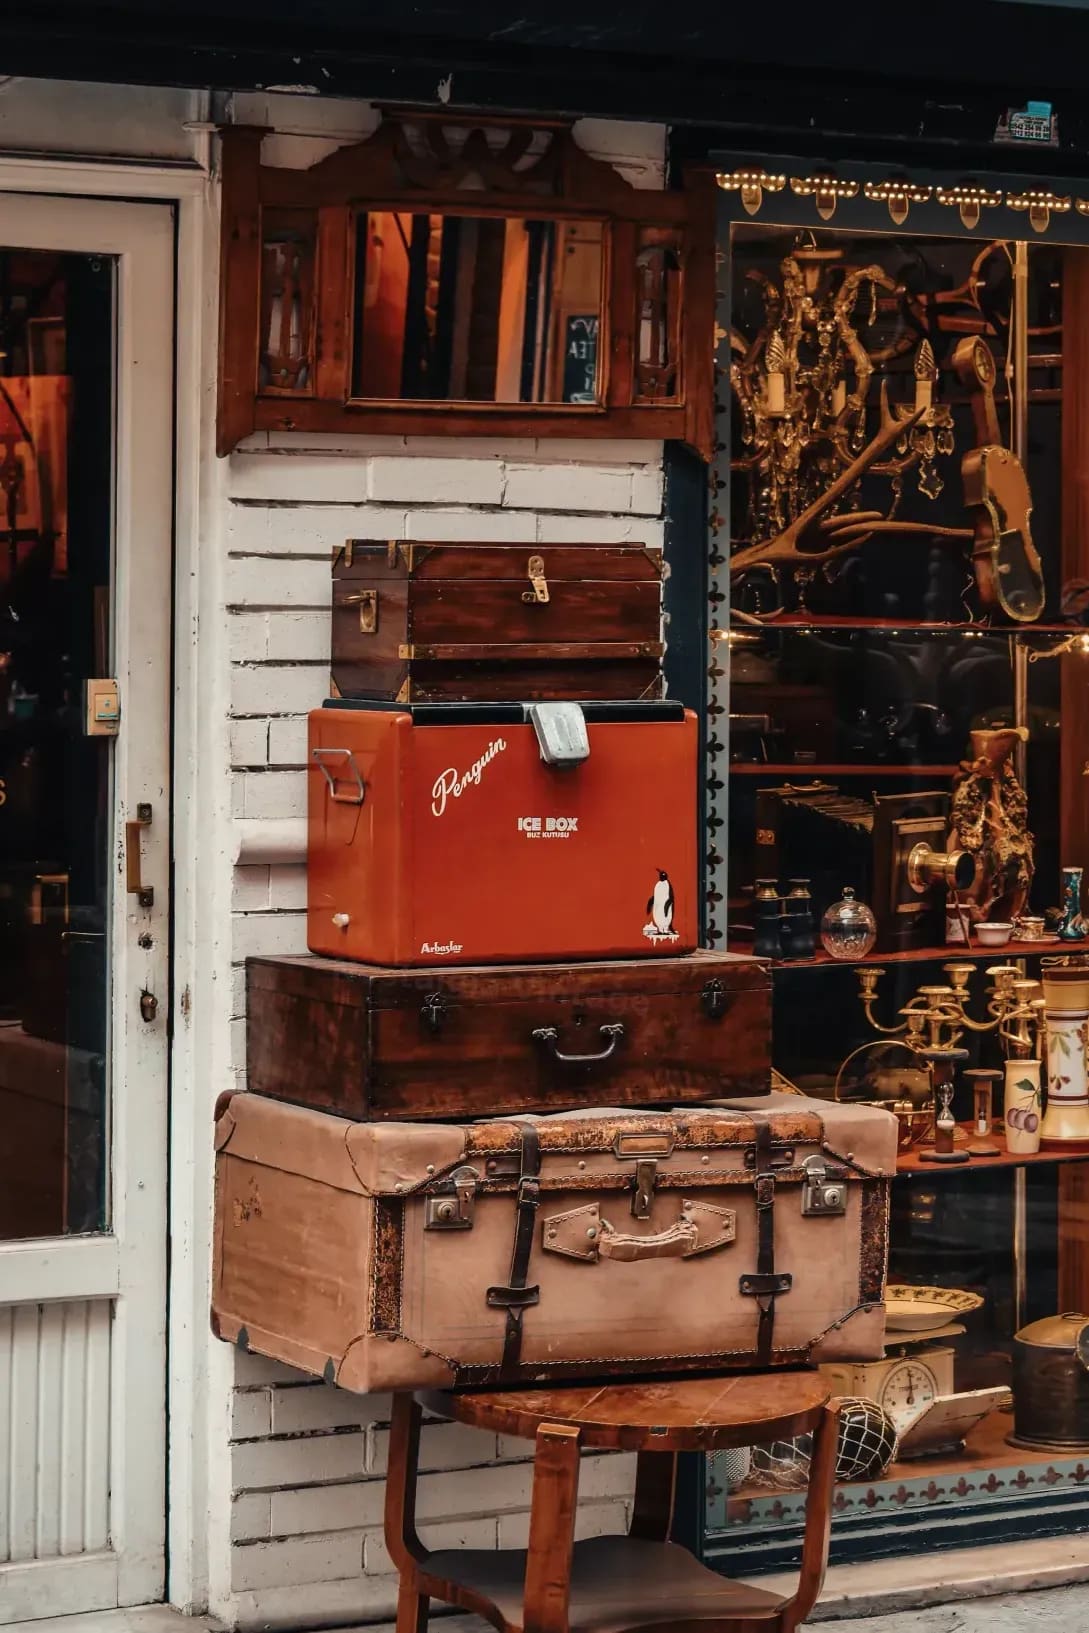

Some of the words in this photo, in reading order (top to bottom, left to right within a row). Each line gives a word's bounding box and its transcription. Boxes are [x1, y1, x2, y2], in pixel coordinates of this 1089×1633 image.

[431, 737, 507, 817] Penguin
[517, 816, 542, 832] ICE
[545, 816, 579, 832] BOX
[526, 831, 541, 839] BUZ
[542, 831, 570, 839] KUTUSU
